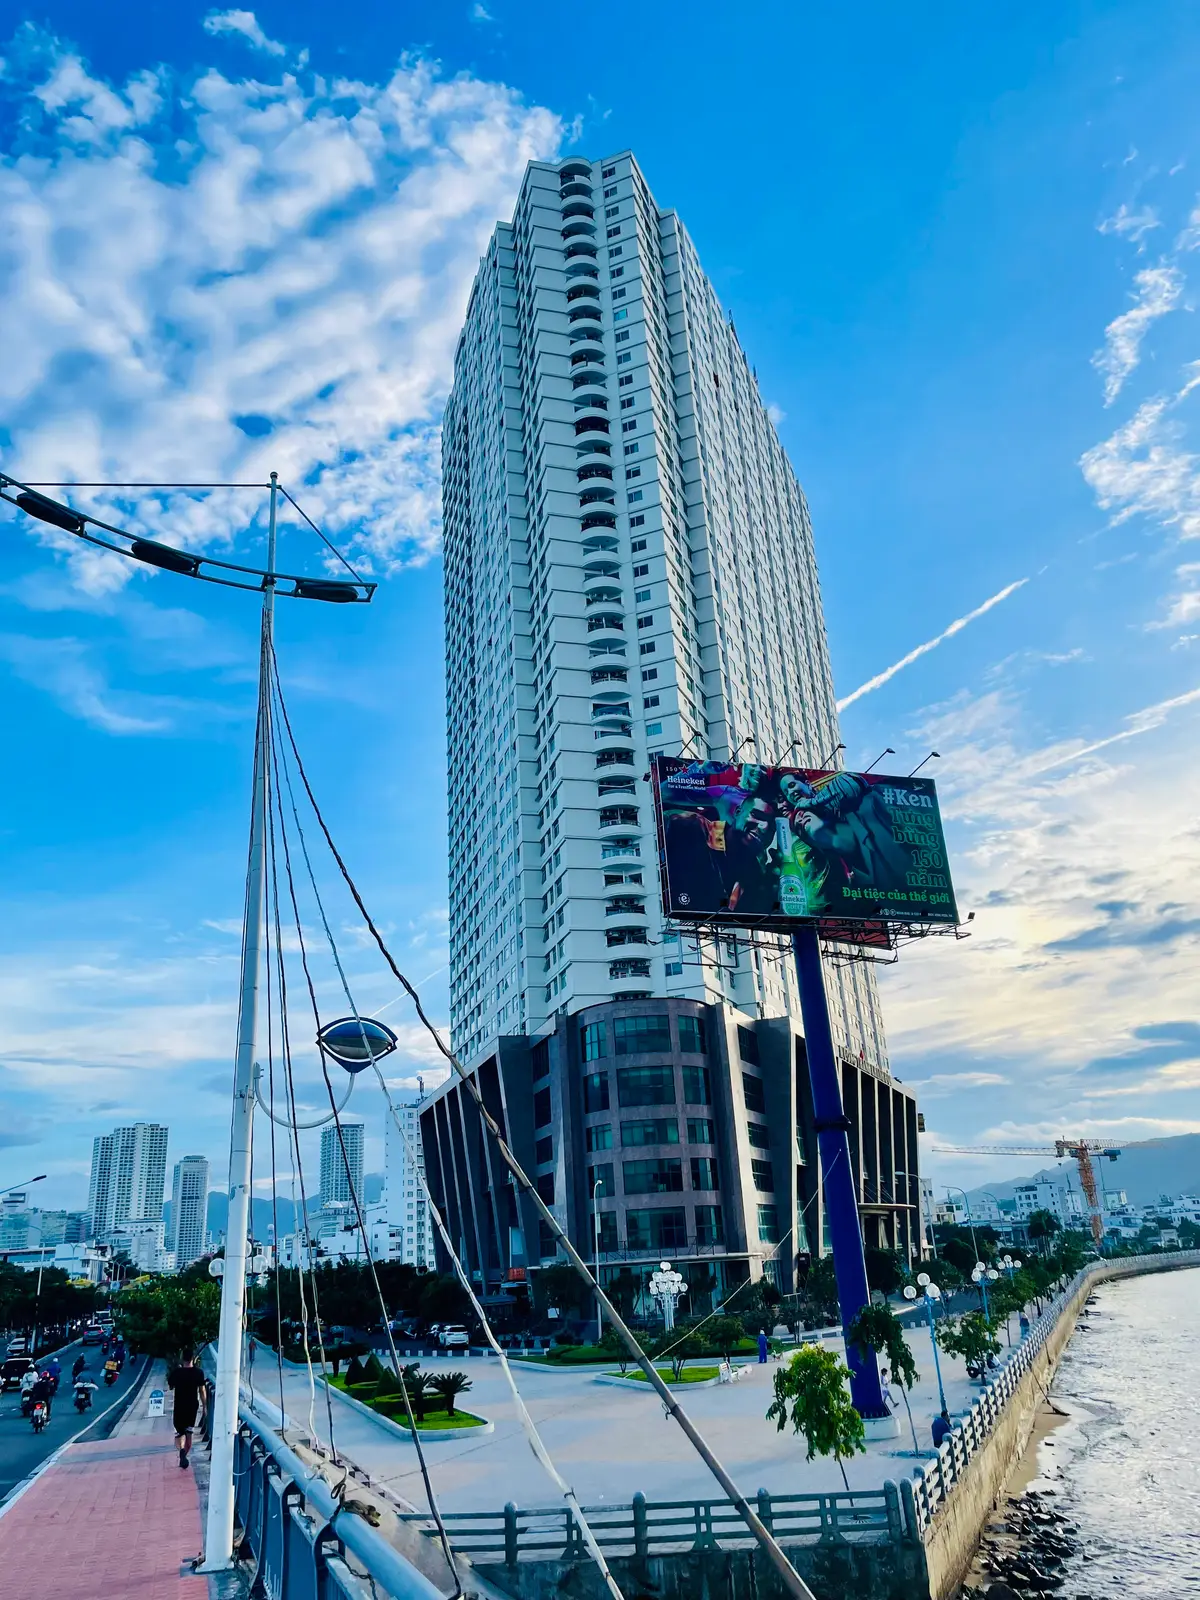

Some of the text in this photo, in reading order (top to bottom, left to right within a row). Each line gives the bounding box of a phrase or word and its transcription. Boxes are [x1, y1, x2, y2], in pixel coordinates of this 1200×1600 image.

[667, 776, 706, 786] Heineken
[883, 788, 932, 808] #Ken
[911, 850, 943, 868] 150
[906, 868, 948, 888] năm
[842, 886, 950, 904] Đại tiệc của thế giới
